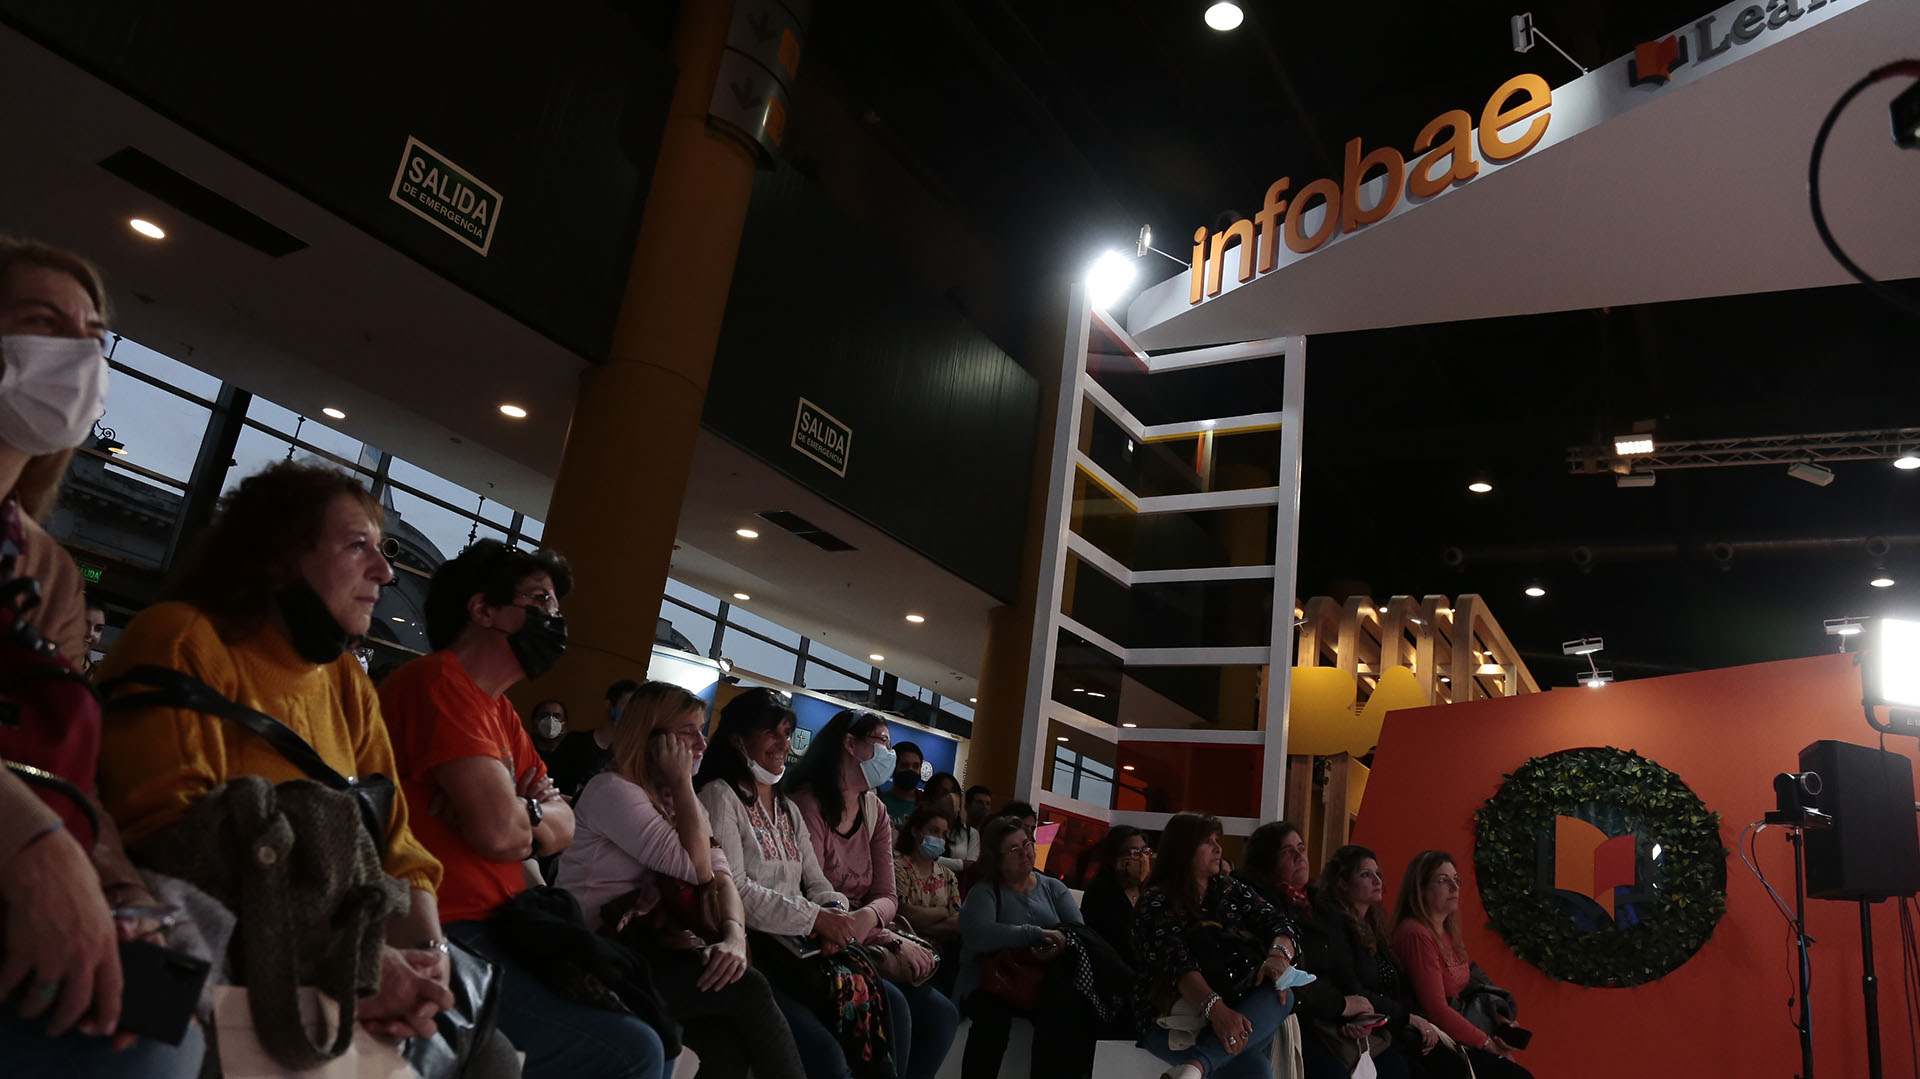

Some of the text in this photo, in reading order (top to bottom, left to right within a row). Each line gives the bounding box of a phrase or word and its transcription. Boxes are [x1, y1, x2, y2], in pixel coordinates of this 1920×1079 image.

[1696, 0, 1837, 61] Lea
[402, 182, 483, 239] DE EMERGENCIA
[408, 156, 487, 226] SALIDA
[1190, 73, 1552, 305] infobae
[797, 432, 843, 465] DE EMERGENCIA
[800, 411, 844, 455] SALIDA
